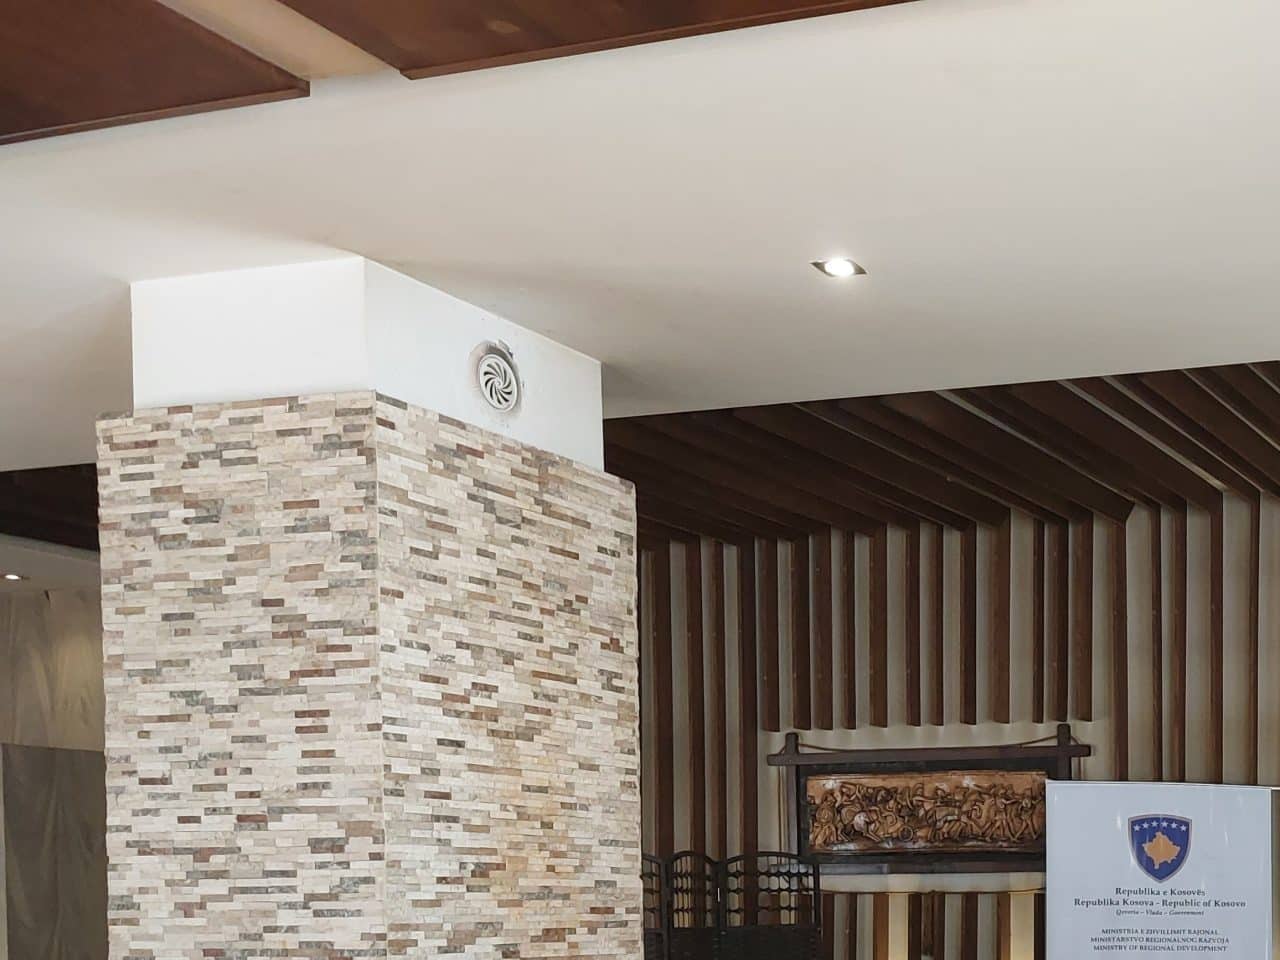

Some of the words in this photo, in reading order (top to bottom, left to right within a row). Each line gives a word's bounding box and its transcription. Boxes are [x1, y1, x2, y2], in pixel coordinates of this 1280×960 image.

[1115, 887, 1160, 897] Republika
[1074, 898, 1120, 908] Republika
[1122, 898, 1154, 906] Kosova
[1162, 898, 1200, 909] Republic
[1203, 899, 1211, 907] of
